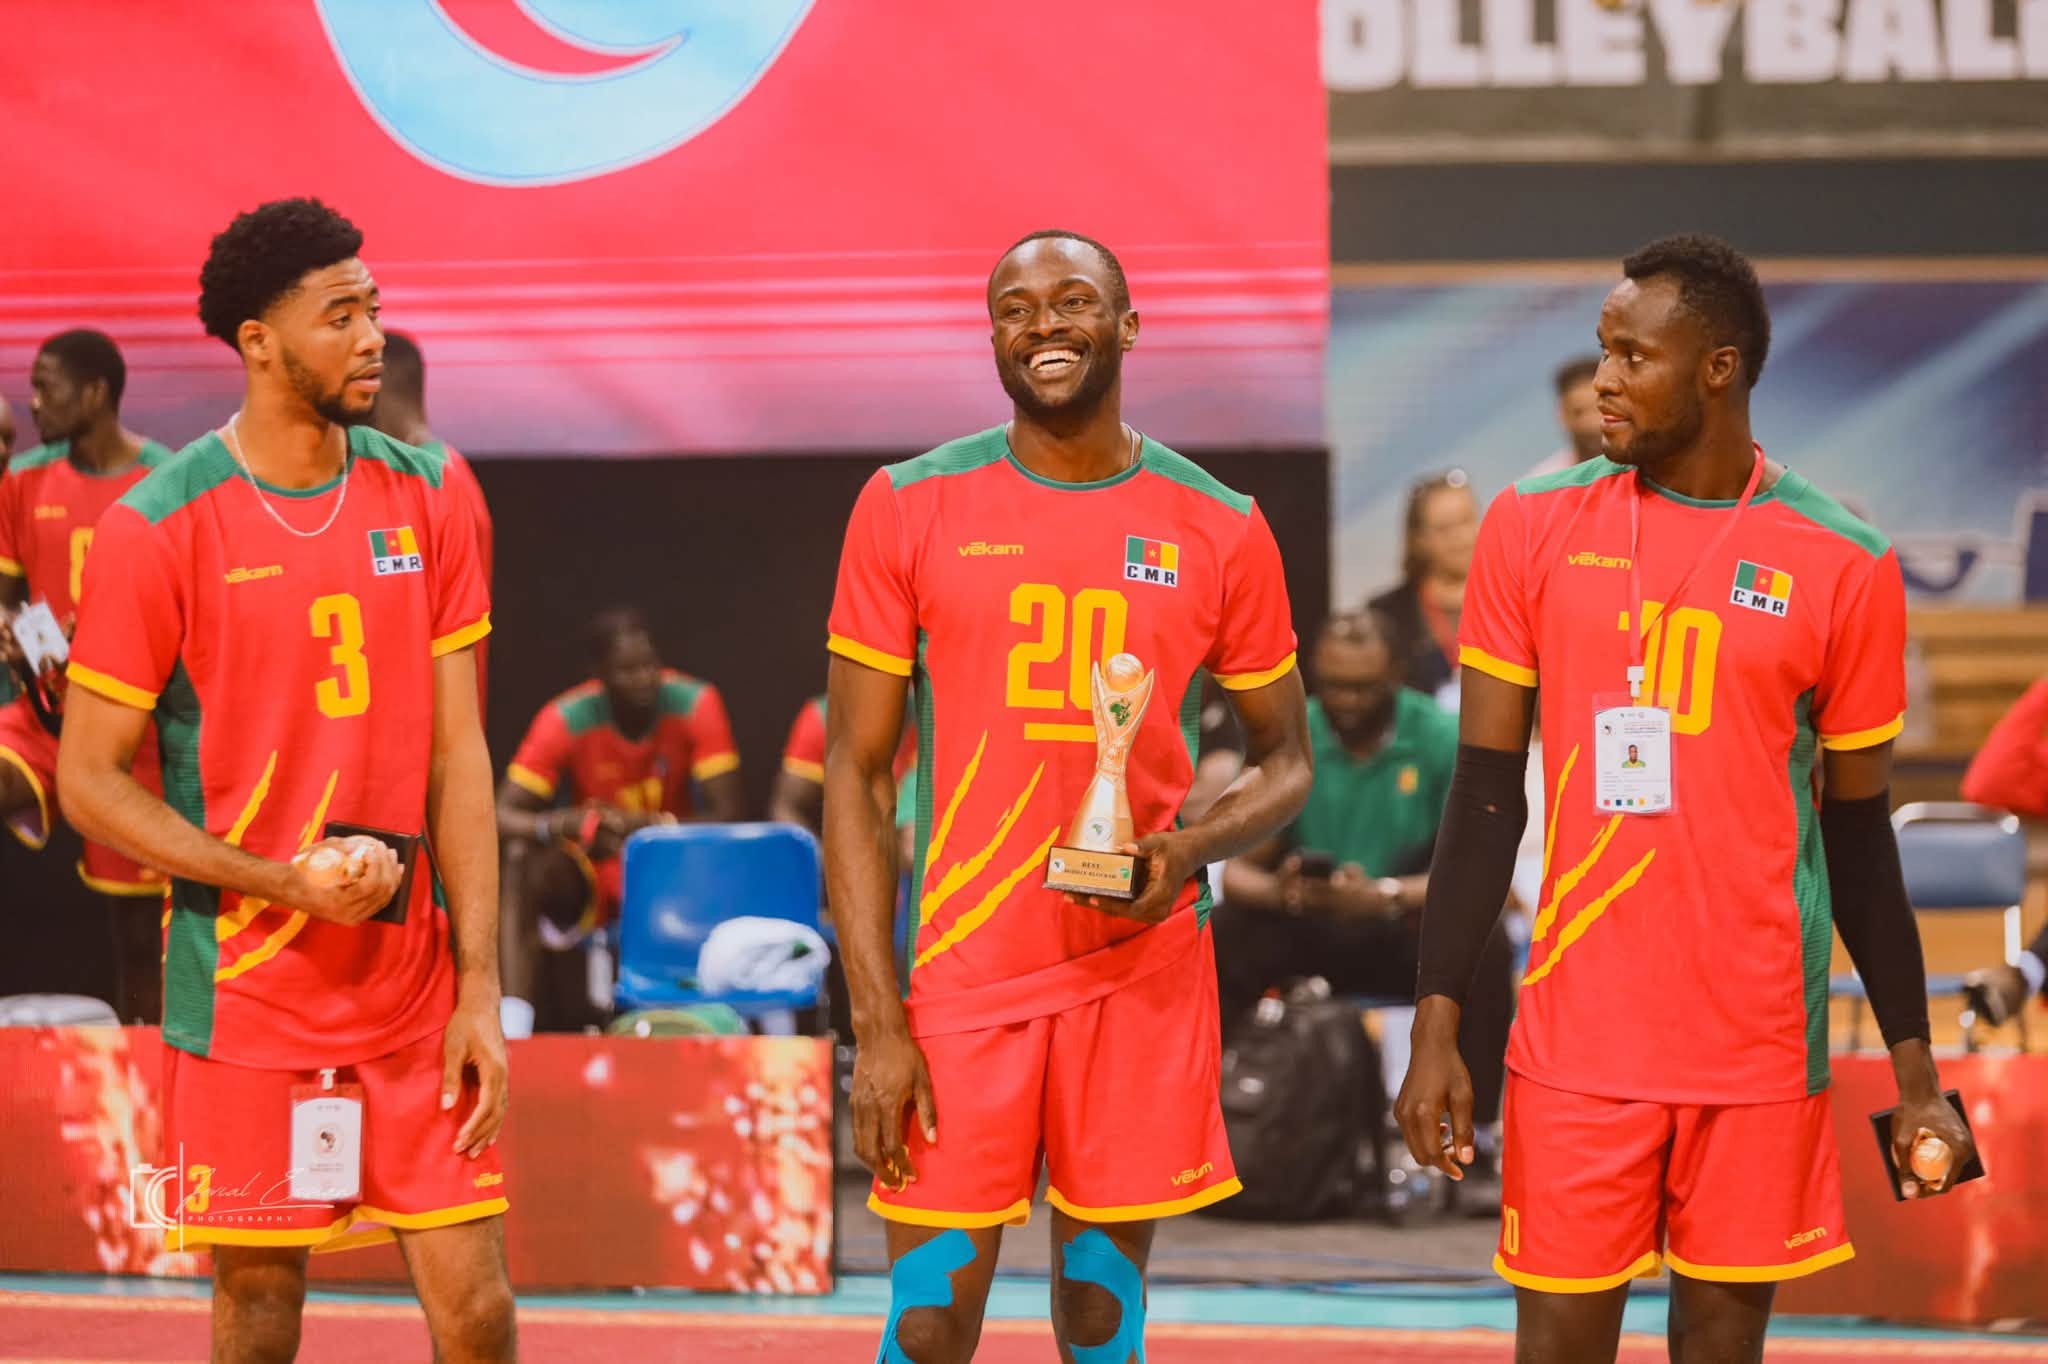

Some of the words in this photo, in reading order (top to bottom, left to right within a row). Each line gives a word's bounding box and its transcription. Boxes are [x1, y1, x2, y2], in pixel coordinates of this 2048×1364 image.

[376, 556, 422, 574] CMR
[1126, 565, 1176, 586] CMR
[1733, 589, 1787, 615] CMR
[309, 592, 370, 719] 3
[1006, 583, 1128, 711] 20
[1617, 600, 1723, 736] 10
[186, 1164, 210, 1213] 3
